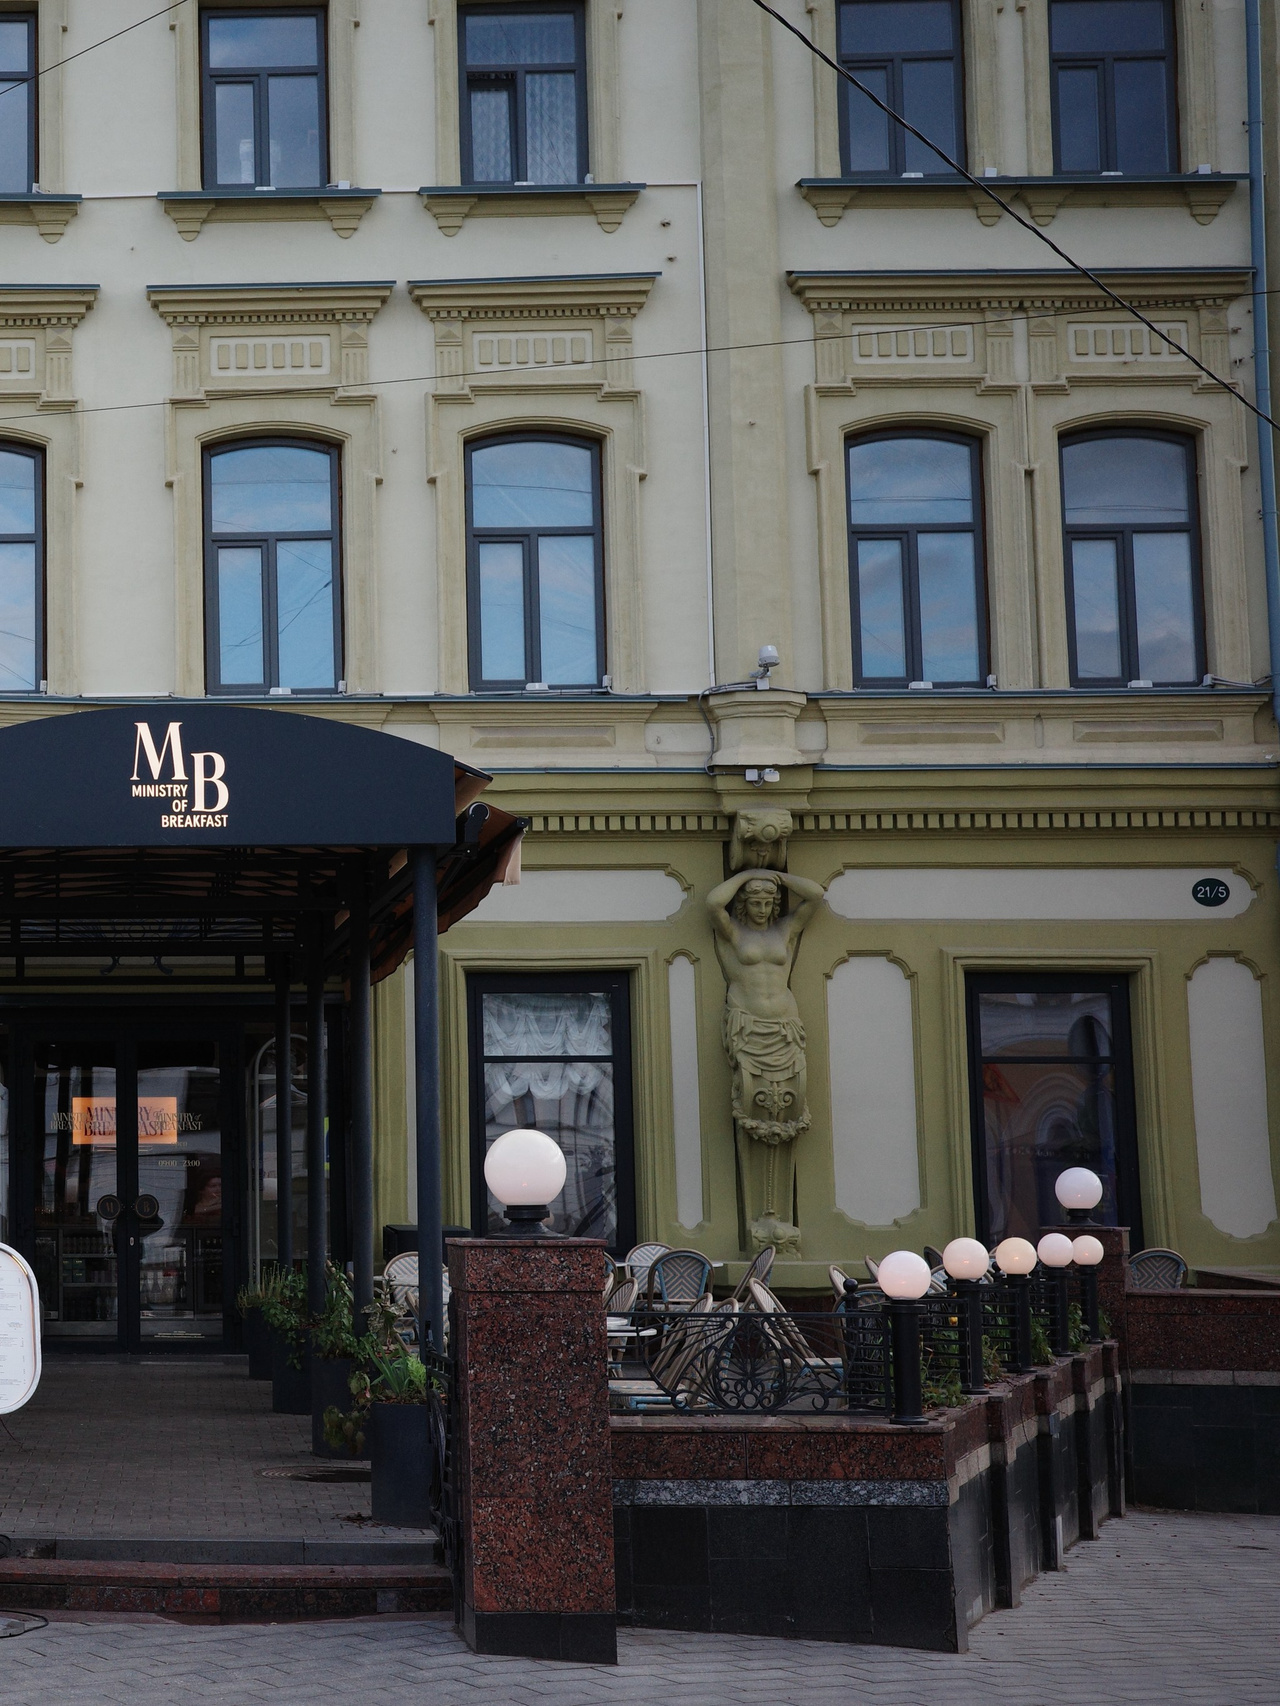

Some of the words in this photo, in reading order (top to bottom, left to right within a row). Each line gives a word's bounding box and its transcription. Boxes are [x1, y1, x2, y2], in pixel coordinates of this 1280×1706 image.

[132, 784, 188, 797] MINISTRY
[172, 799, 188, 812] OF
[161, 814, 229, 828] BREAKFAST
[1197, 886, 1227, 898] 21/5
